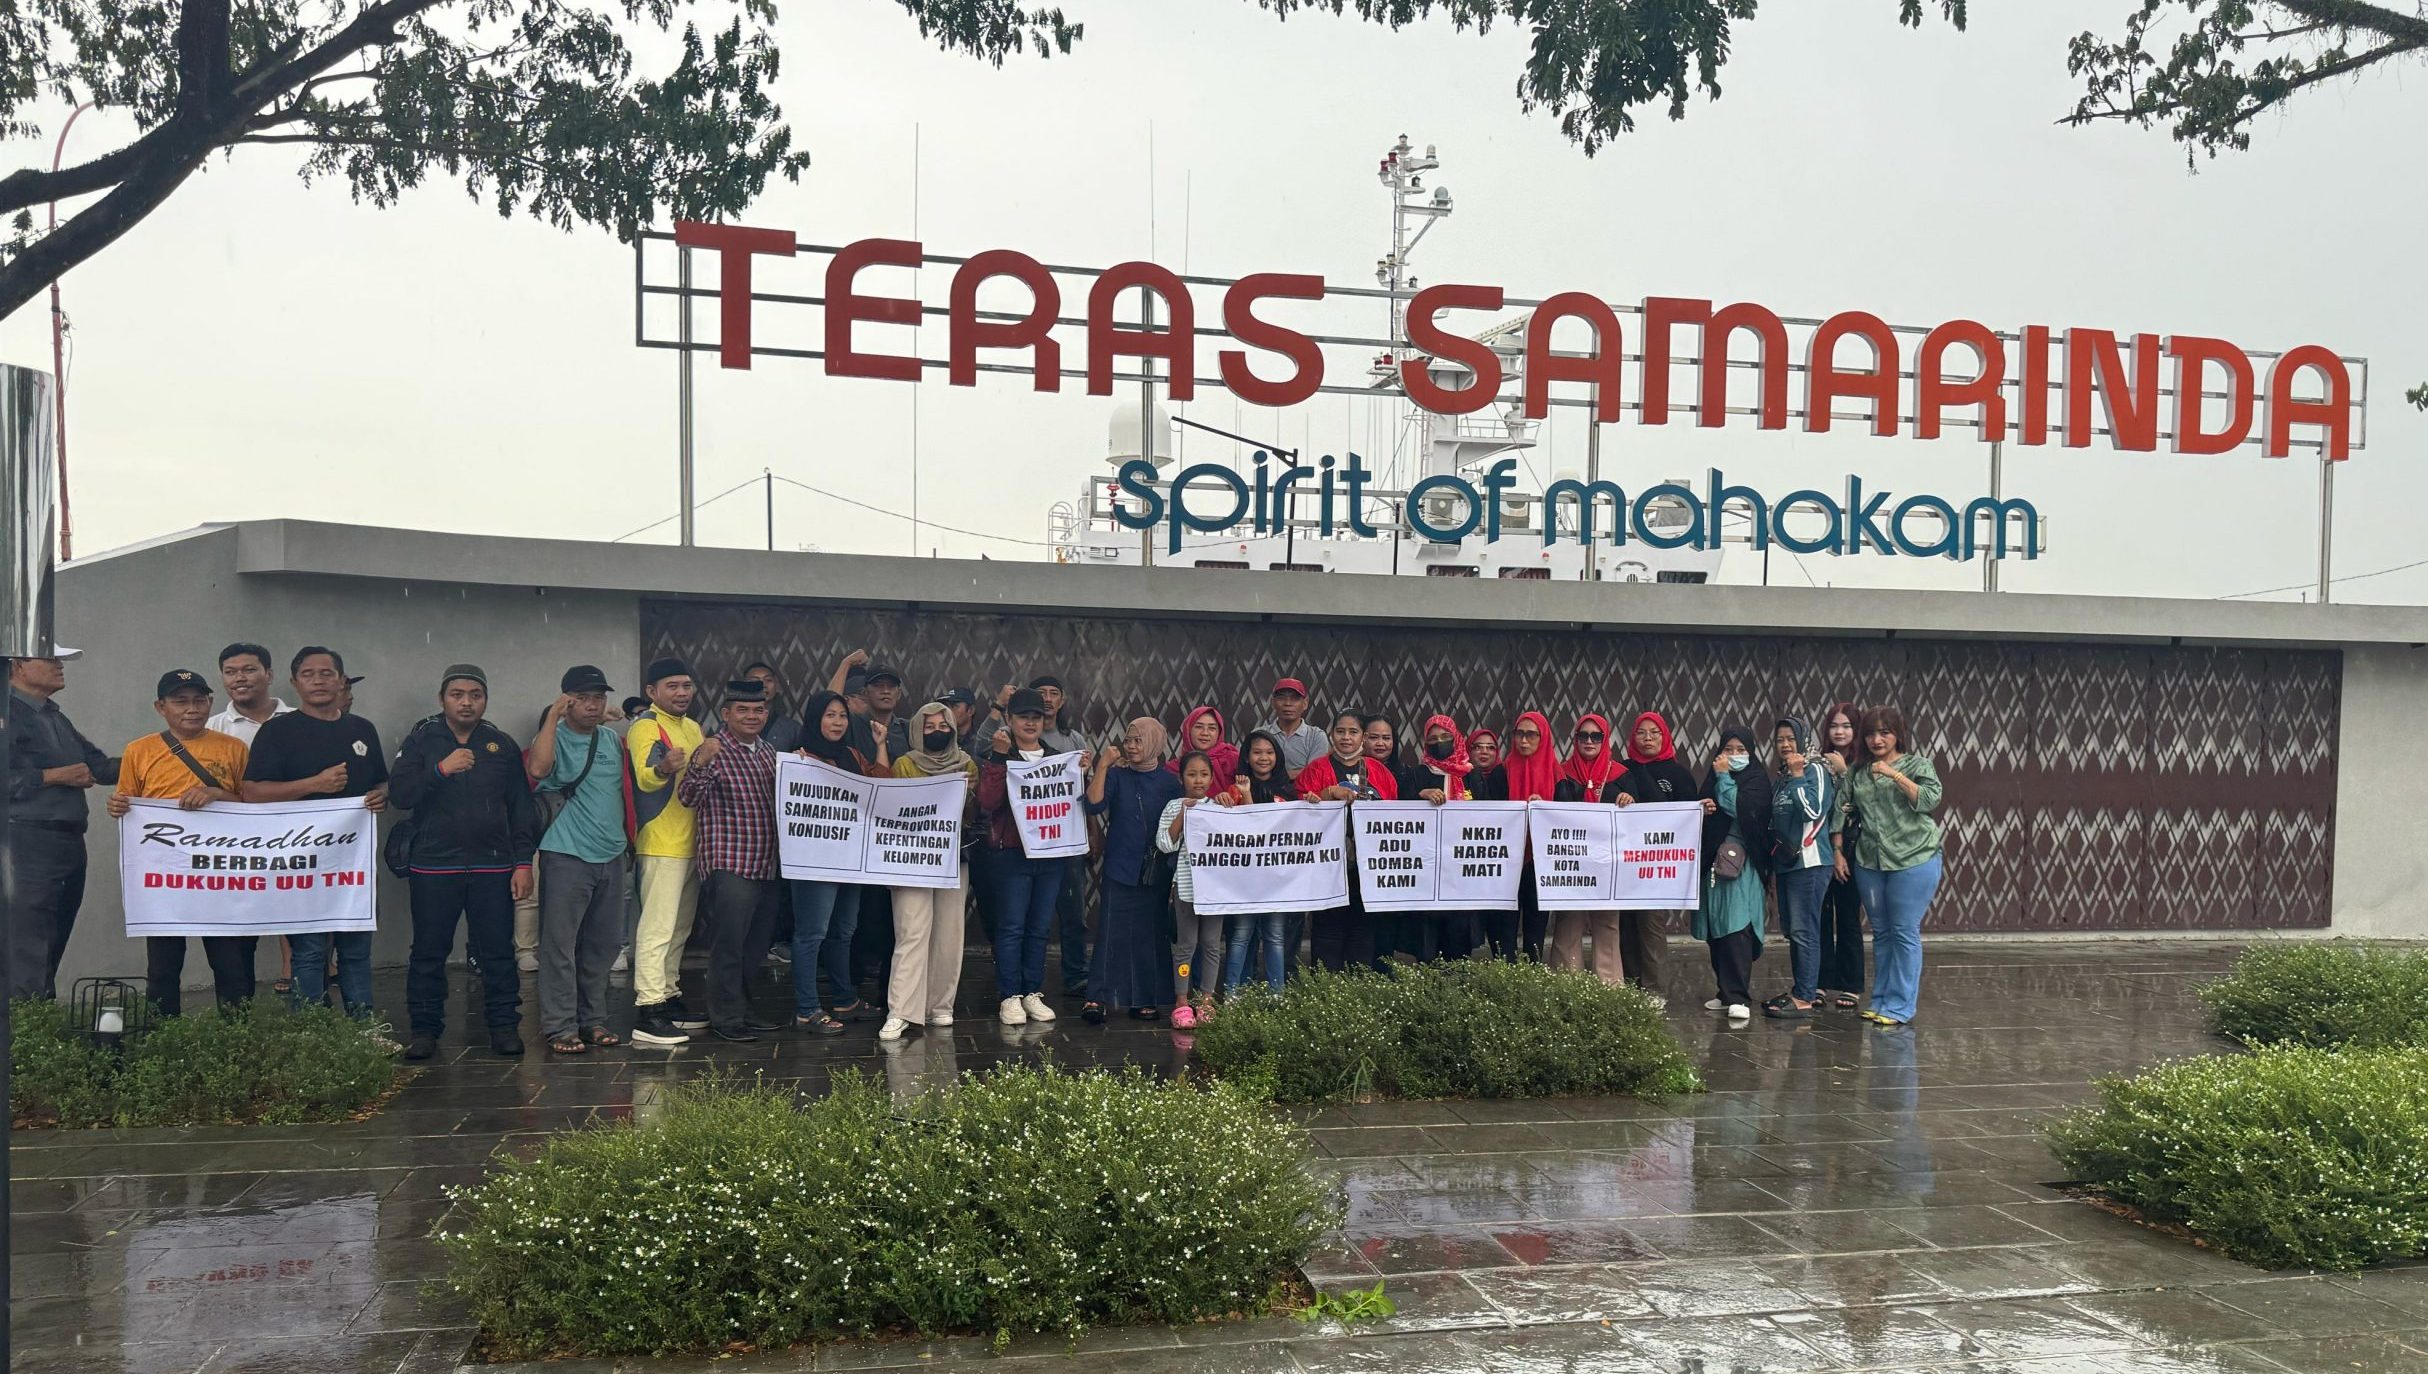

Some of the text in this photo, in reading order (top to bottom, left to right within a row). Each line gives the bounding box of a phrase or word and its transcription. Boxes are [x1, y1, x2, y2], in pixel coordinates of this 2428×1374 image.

[674, 220, 2350, 461] TERAS SAMARINDA
[1112, 449, 2039, 562] spirit of mahakam
[789, 781, 860, 804] WUJUDKAN
[1020, 781, 1075, 800] RAKYAT
[784, 801, 859, 822] SAMARINDA
[897, 803, 938, 818] JANGAN
[1025, 802, 1072, 821] HIDUP
[788, 821, 851, 841] KONDUSIF
[874, 816, 957, 833] TERPROVOKASI
[1039, 824, 1061, 840] TNI
[1365, 821, 1425, 834] JANGAN
[140, 822, 358, 850] Ramadhan
[875, 832, 951, 850] KEPENTINGAN
[1206, 831, 1324, 849] JANGAN PERNAH
[1462, 827, 1503, 841] NKRI
[1550, 828, 1570, 841] AYO
[1643, 832, 1675, 845] KAMI
[1378, 839, 1411, 852] ADU
[1453, 845, 1509, 859] HARGA
[1547, 844, 1588, 857] BANGUN
[191, 854, 318, 871] BERBAGI
[883, 850, 943, 866] KELOMPOK
[1190, 848, 1341, 867] GANGGU TENTARA KU
[1623, 848, 1696, 863] MENDUKUNG
[1367, 857, 1423, 871] DOMBA
[1462, 863, 1502, 877] MATI
[1554, 859, 1580, 872] KOTA
[1638, 866, 1677, 879] UU TNI
[144, 871, 366, 891] DUKUNG UU TNI
[1376, 874, 1416, 889] KAMI
[1540, 875, 1597, 887] SAMARINDA
